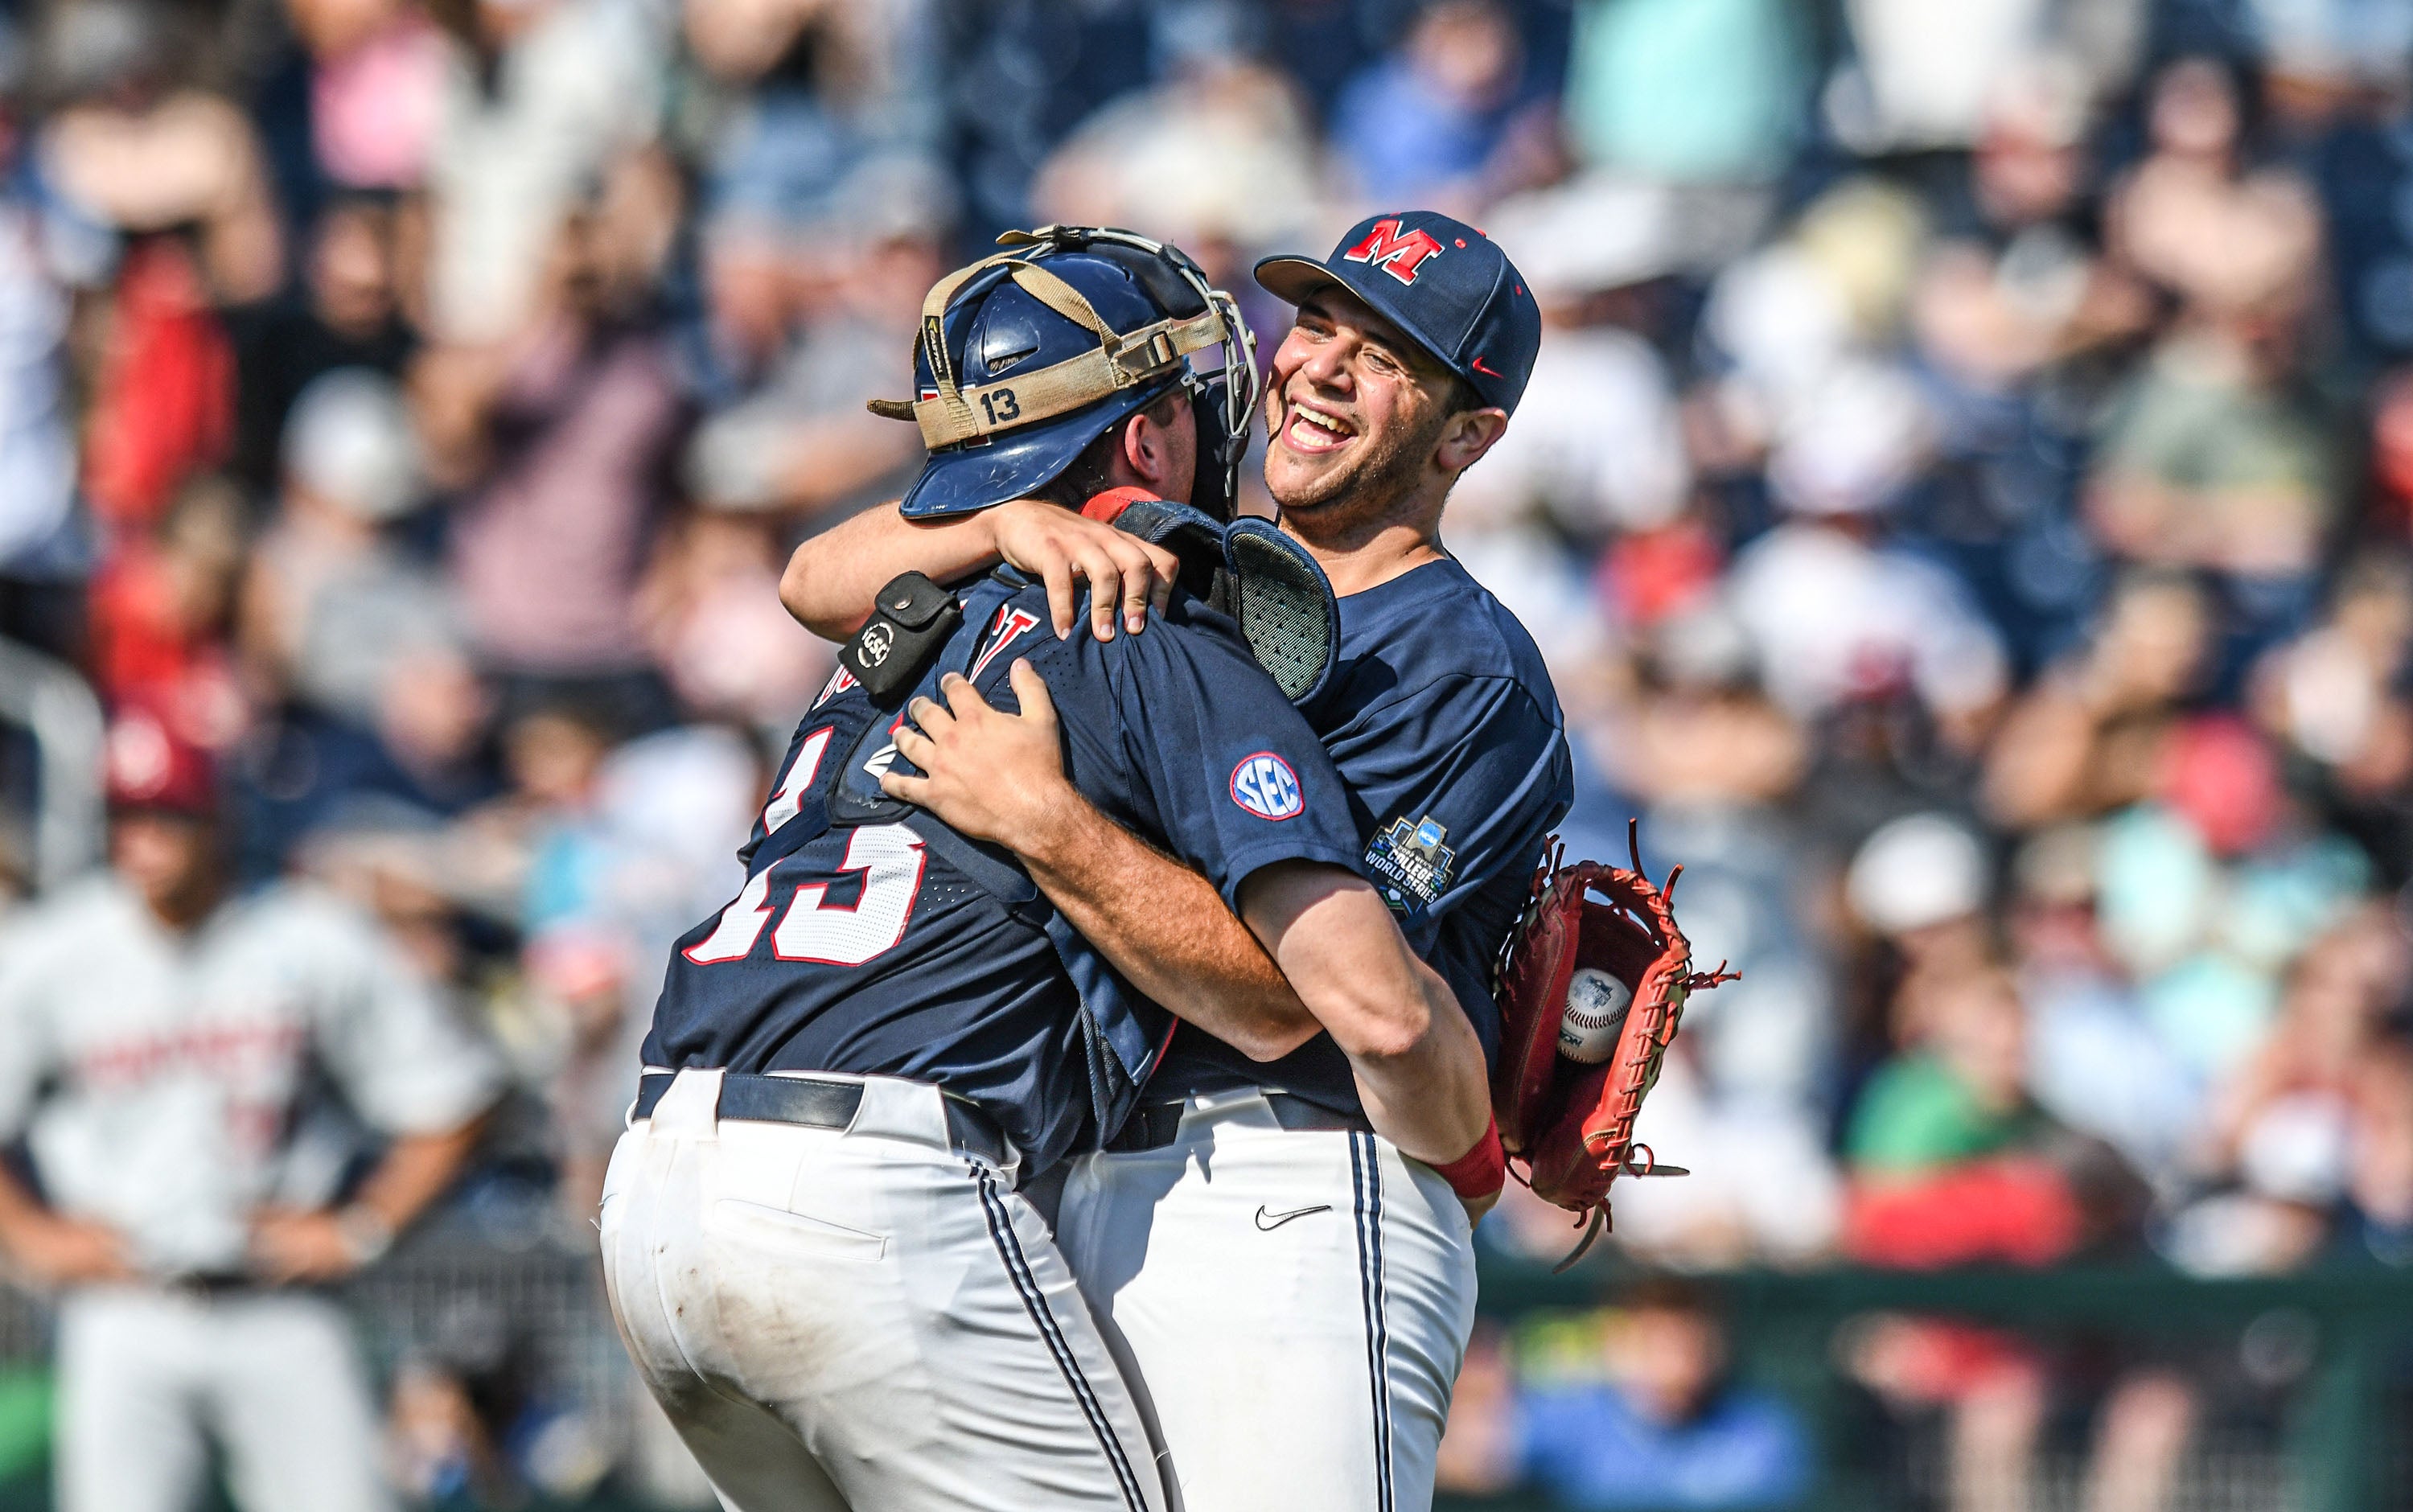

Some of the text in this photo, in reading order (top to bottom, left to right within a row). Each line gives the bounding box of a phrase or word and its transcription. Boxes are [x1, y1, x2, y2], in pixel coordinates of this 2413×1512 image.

[1343, 219, 1445, 286] M
[980, 388, 1021, 425] 13
[1236, 758, 1298, 816] SEC
[1365, 851, 1438, 904] WORLD SERIES
[1387, 848, 1433, 884] COLLEGE
[1387, 879, 1411, 897] OMAHA
